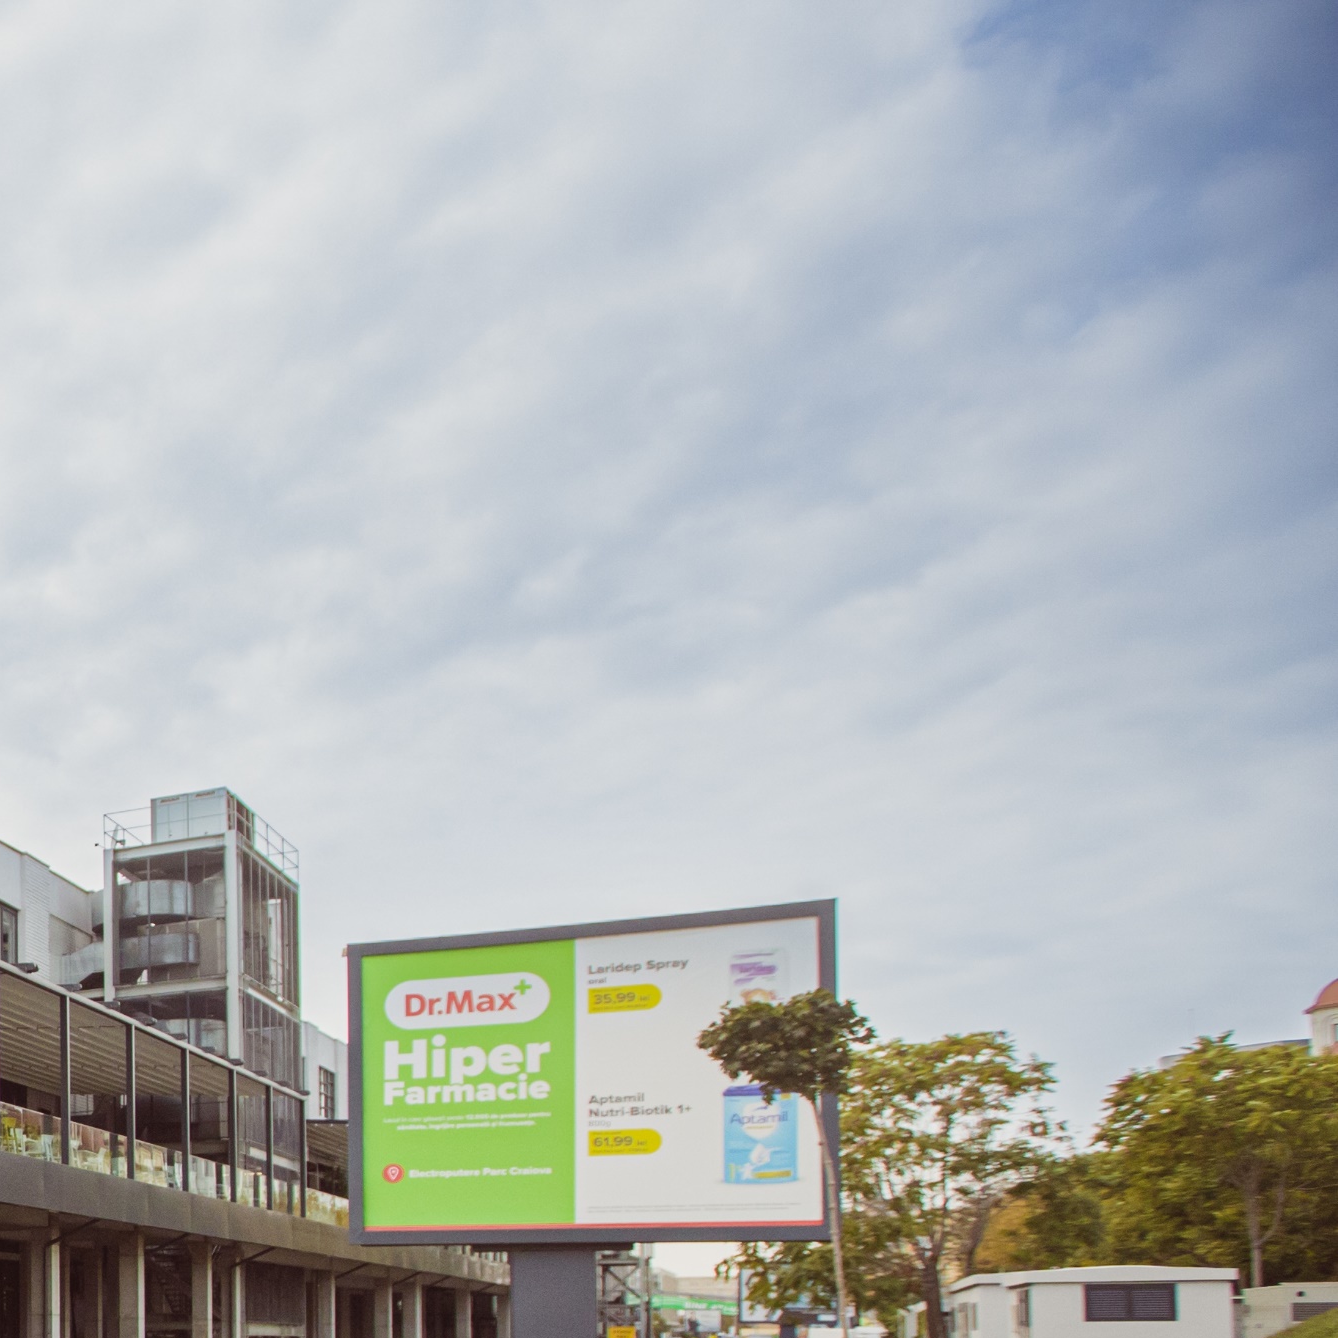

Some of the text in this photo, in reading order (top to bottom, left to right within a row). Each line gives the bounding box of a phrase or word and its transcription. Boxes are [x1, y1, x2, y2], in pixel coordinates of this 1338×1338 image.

[646, 959, 690, 971] Spray
[384, 1034, 552, 1085] Hiper
[383, 1073, 552, 1106] Farmacie
[588, 1092, 645, 1106] Aptamil
[588, 1105, 673, 1117] Nutri-Biotik
